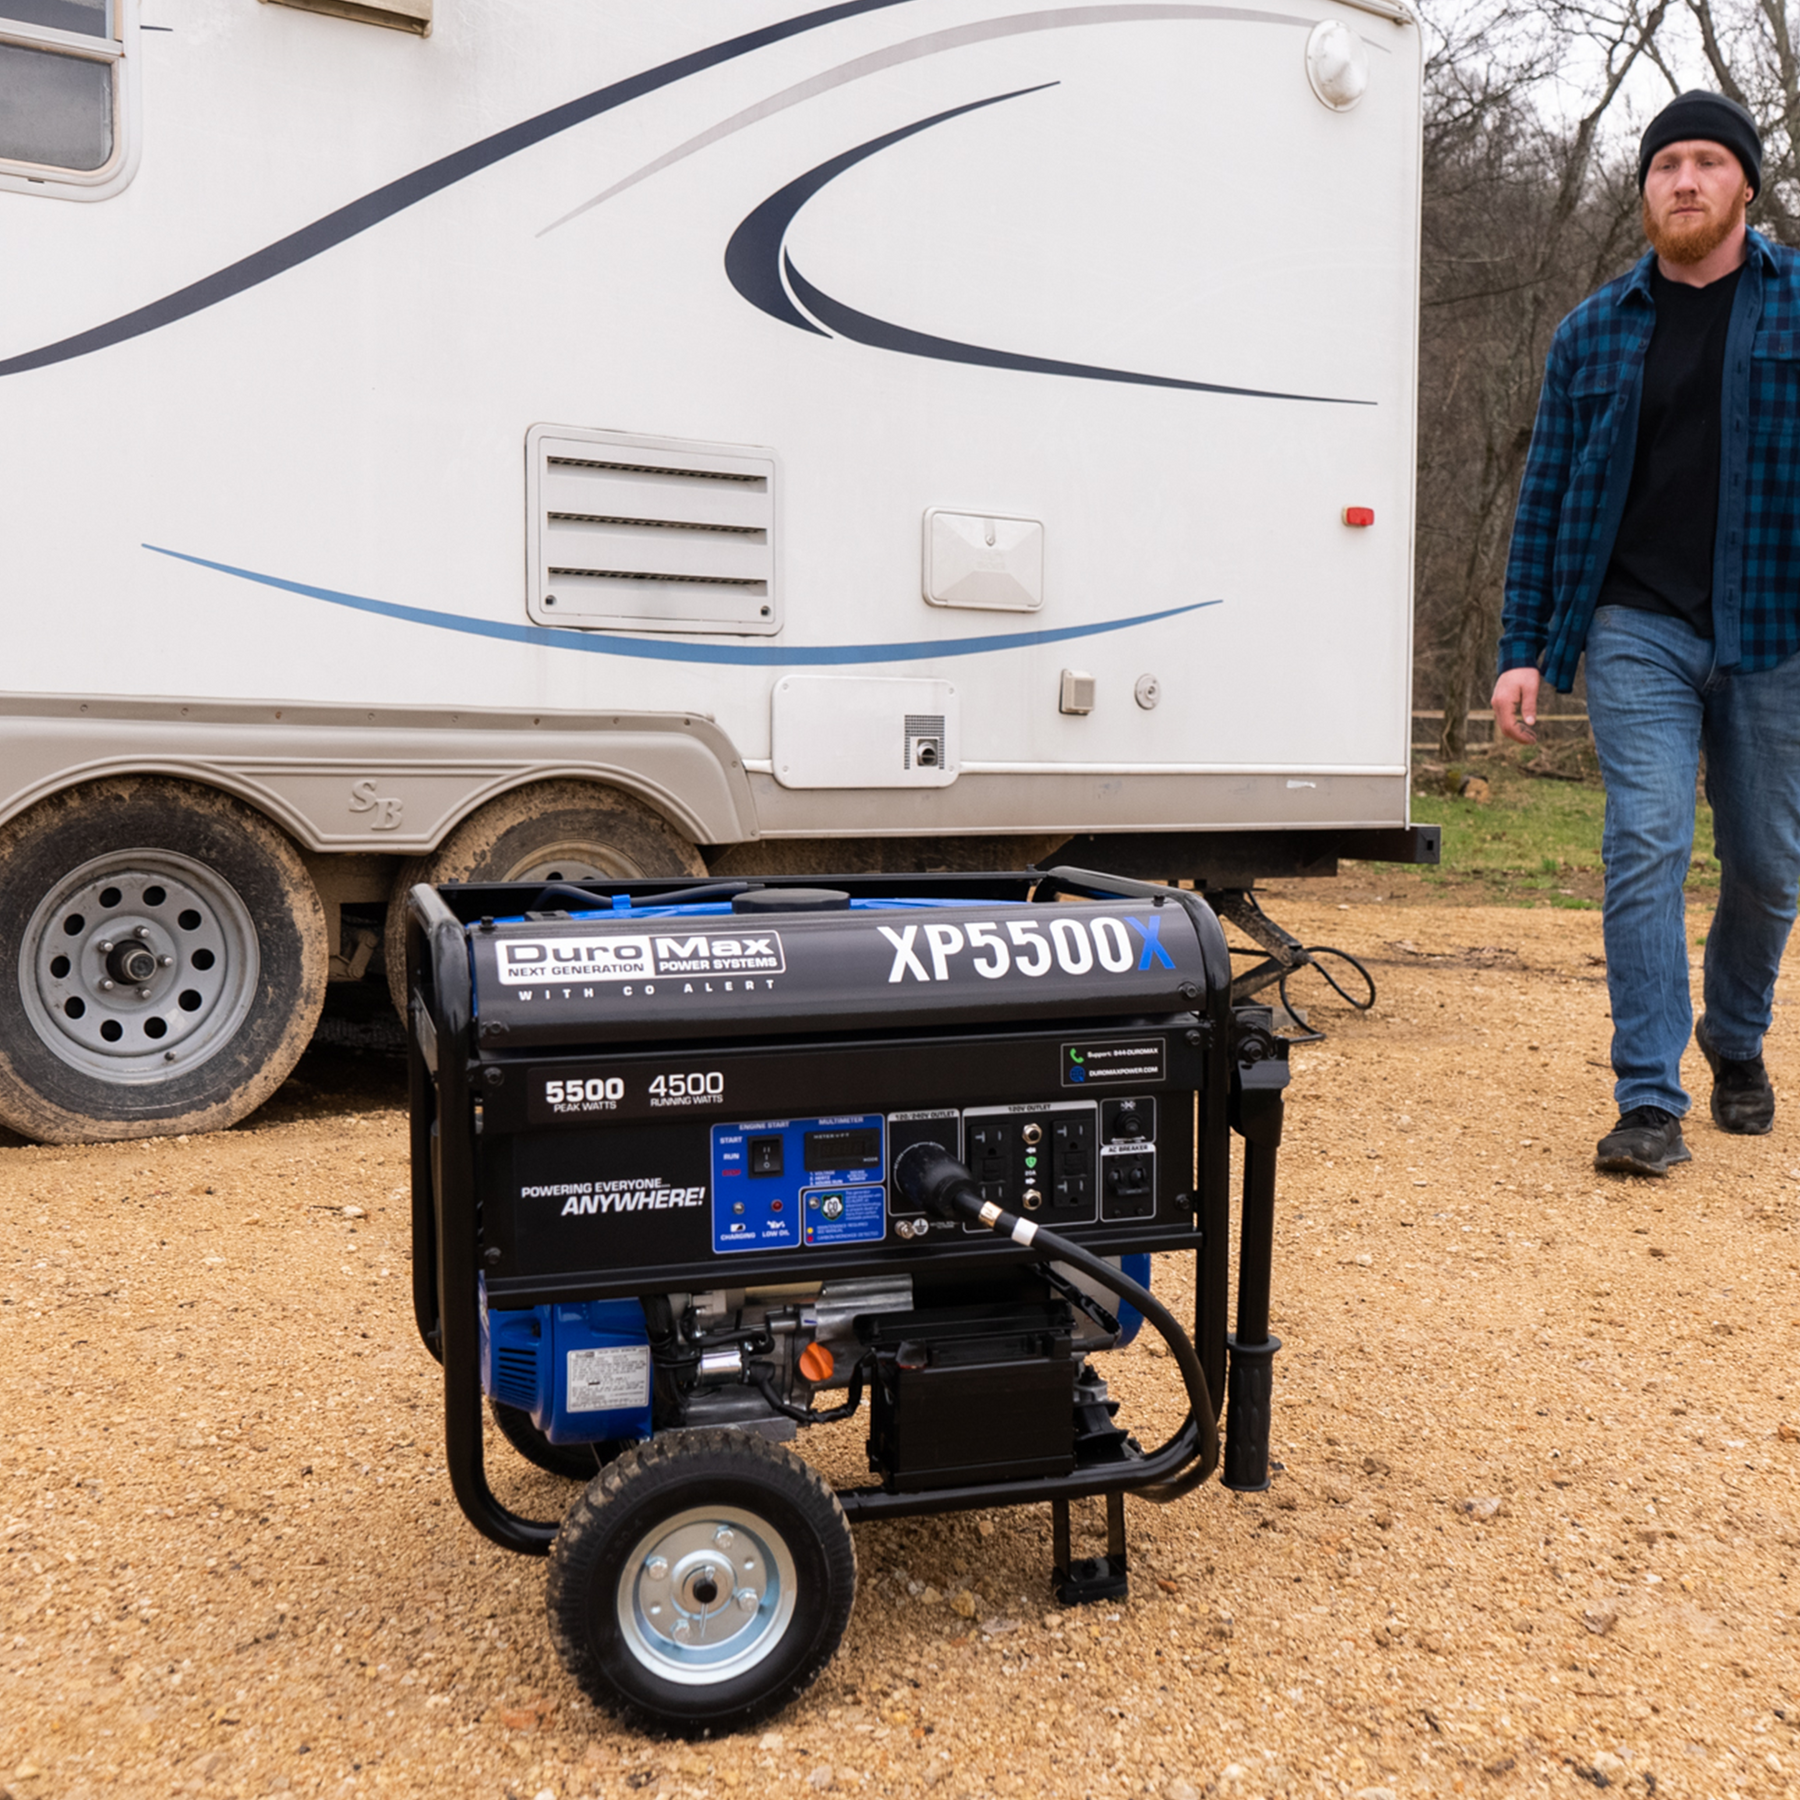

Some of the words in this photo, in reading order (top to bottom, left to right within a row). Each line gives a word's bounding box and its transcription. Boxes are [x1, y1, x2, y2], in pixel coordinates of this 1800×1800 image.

[876, 914, 1176, 983] XP5500X
[508, 966, 547, 977] NEXT
[550, 962, 645, 976] GENERATION
[659, 960, 710, 972] POWER
[712, 957, 778, 970] SYSTEMS
[519, 988, 595, 1001] WITH
[623, 985, 656, 996] CO
[684, 979, 775, 993] ALERT
[546, 1077, 625, 1104] 5500
[648, 1071, 724, 1097] 4500
[554, 1102, 580, 1113] PEAK
[582, 1101, 617, 1111] WATTS
[650, 1096, 692, 1107] RUNNING
[693, 1094, 723, 1104] WATTS
[739, 1123, 766, 1131] ENGINE
[818, 1116, 864, 1125] MULTIMETER
[720, 1136, 742, 1144] START
[1118, 1144, 1148, 1152] BREAKER
[521, 1182, 592, 1198] POWERING
[561, 1187, 706, 1216] ANYWHERE!
[720, 1232, 756, 1241] CHARGING
[762, 1230, 777, 1238] LOW
[779, 1229, 791, 1237] OIL
